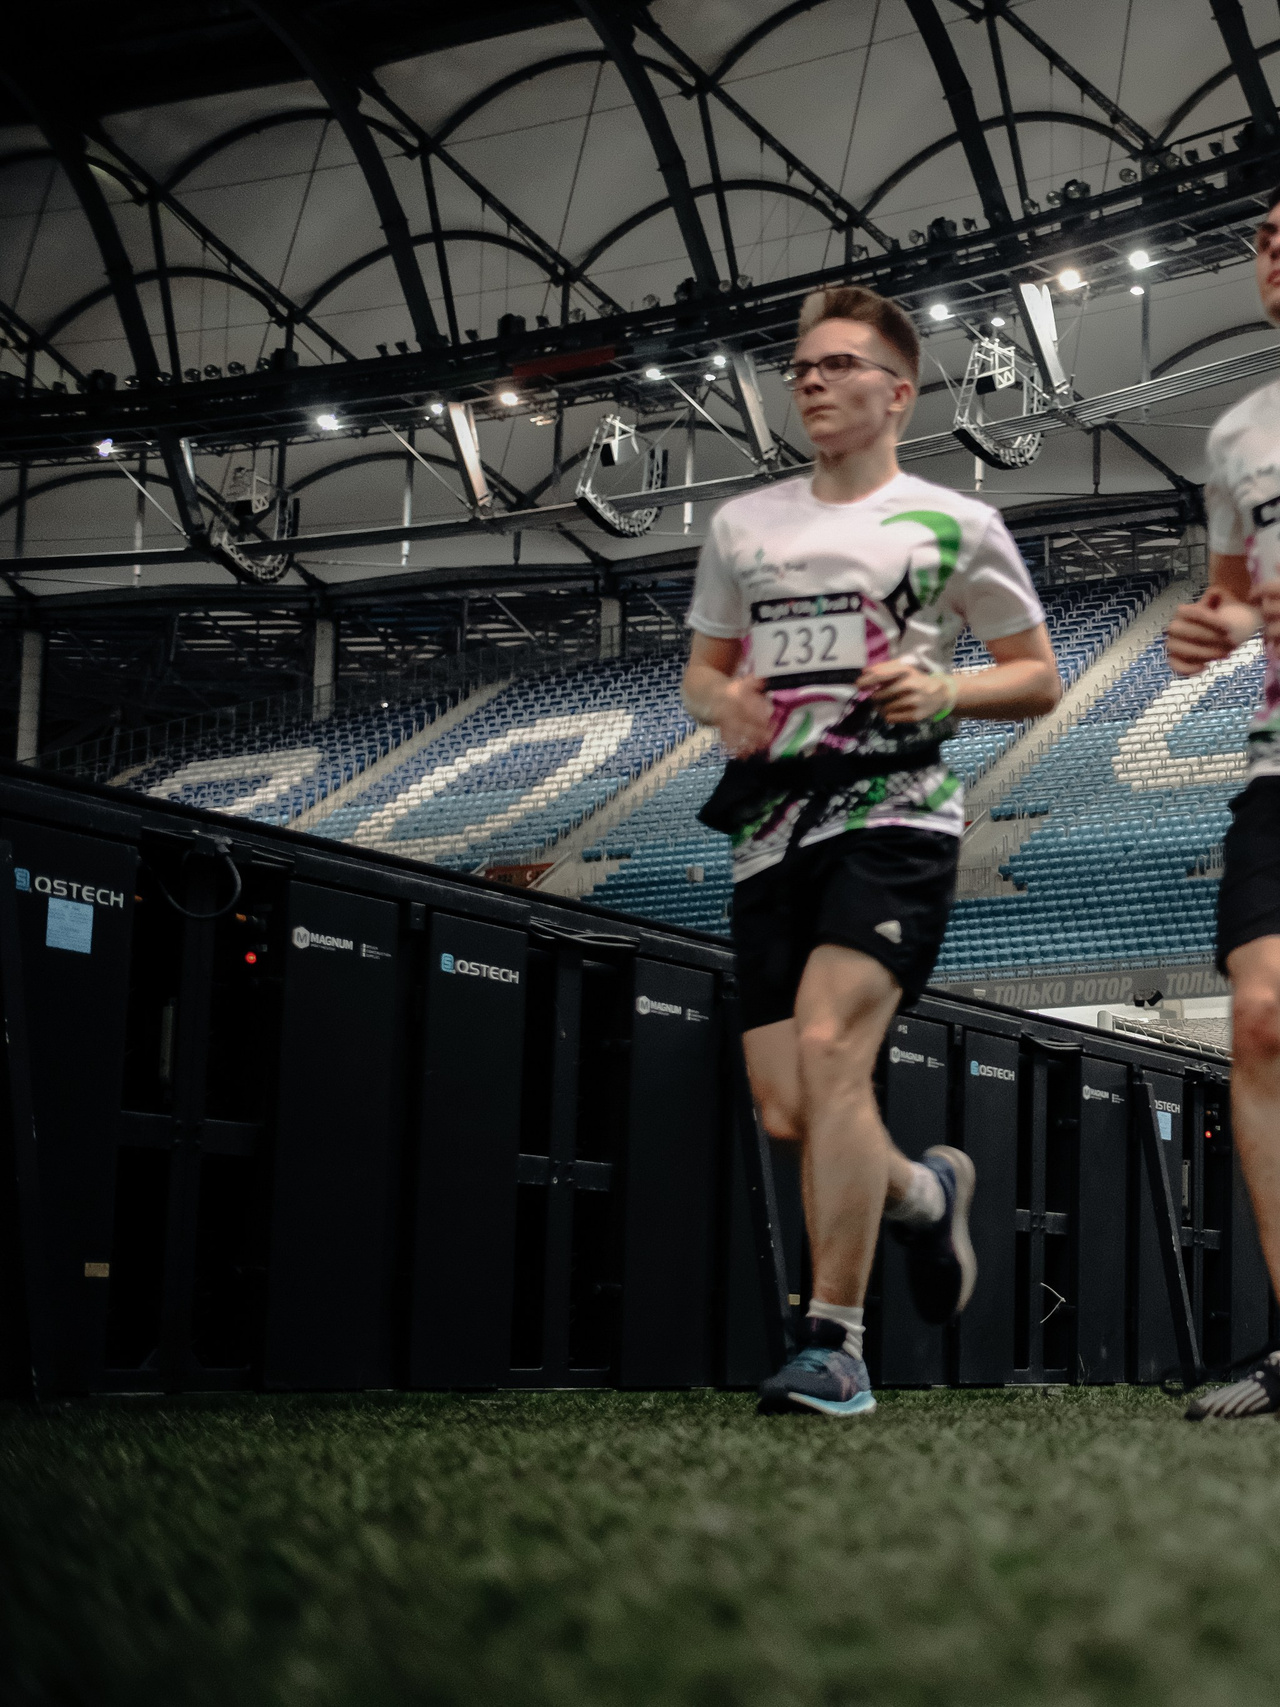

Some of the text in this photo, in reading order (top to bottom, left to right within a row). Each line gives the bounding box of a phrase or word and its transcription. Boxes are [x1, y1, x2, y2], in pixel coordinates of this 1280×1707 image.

[773, 624, 838, 668] 232
[34, 875, 125, 908] QSTECH
[310, 932, 354, 951] MAGNUM
[455, 959, 520, 985] QSTECH
[994, 981, 1066, 1005] ТОЛЬКО
[1165, 972, 1230, 997] ТОЛЬК
[650, 1000, 682, 1015] MAGNUM
[979, 1064, 1016, 1081] QSTECH
